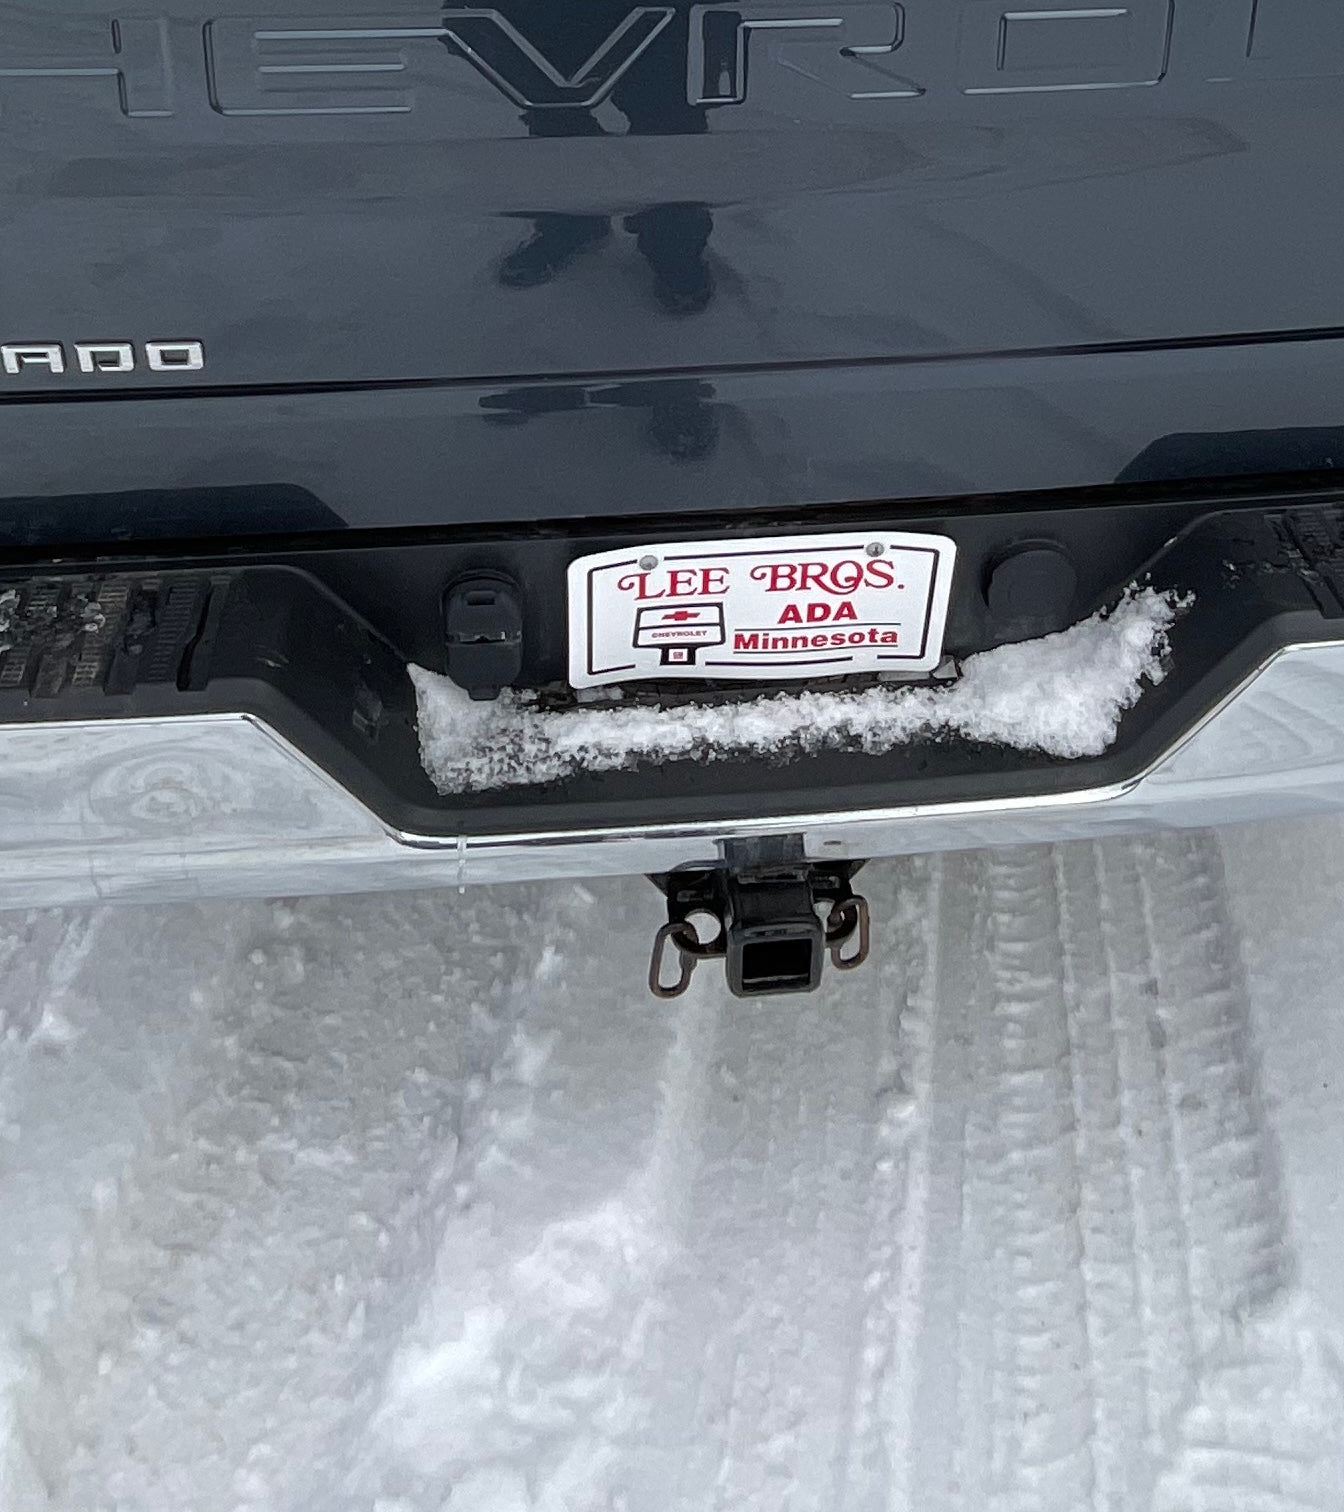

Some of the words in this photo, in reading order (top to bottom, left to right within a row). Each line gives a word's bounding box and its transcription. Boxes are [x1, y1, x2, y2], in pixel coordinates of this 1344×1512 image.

[617, 567, 730, 601] LEE
[750, 559, 905, 596] BROS.
[777, 600, 859, 624] ADA
[651, 630, 708, 639] CHEVROLET
[733, 627, 899, 650] Minnesota
